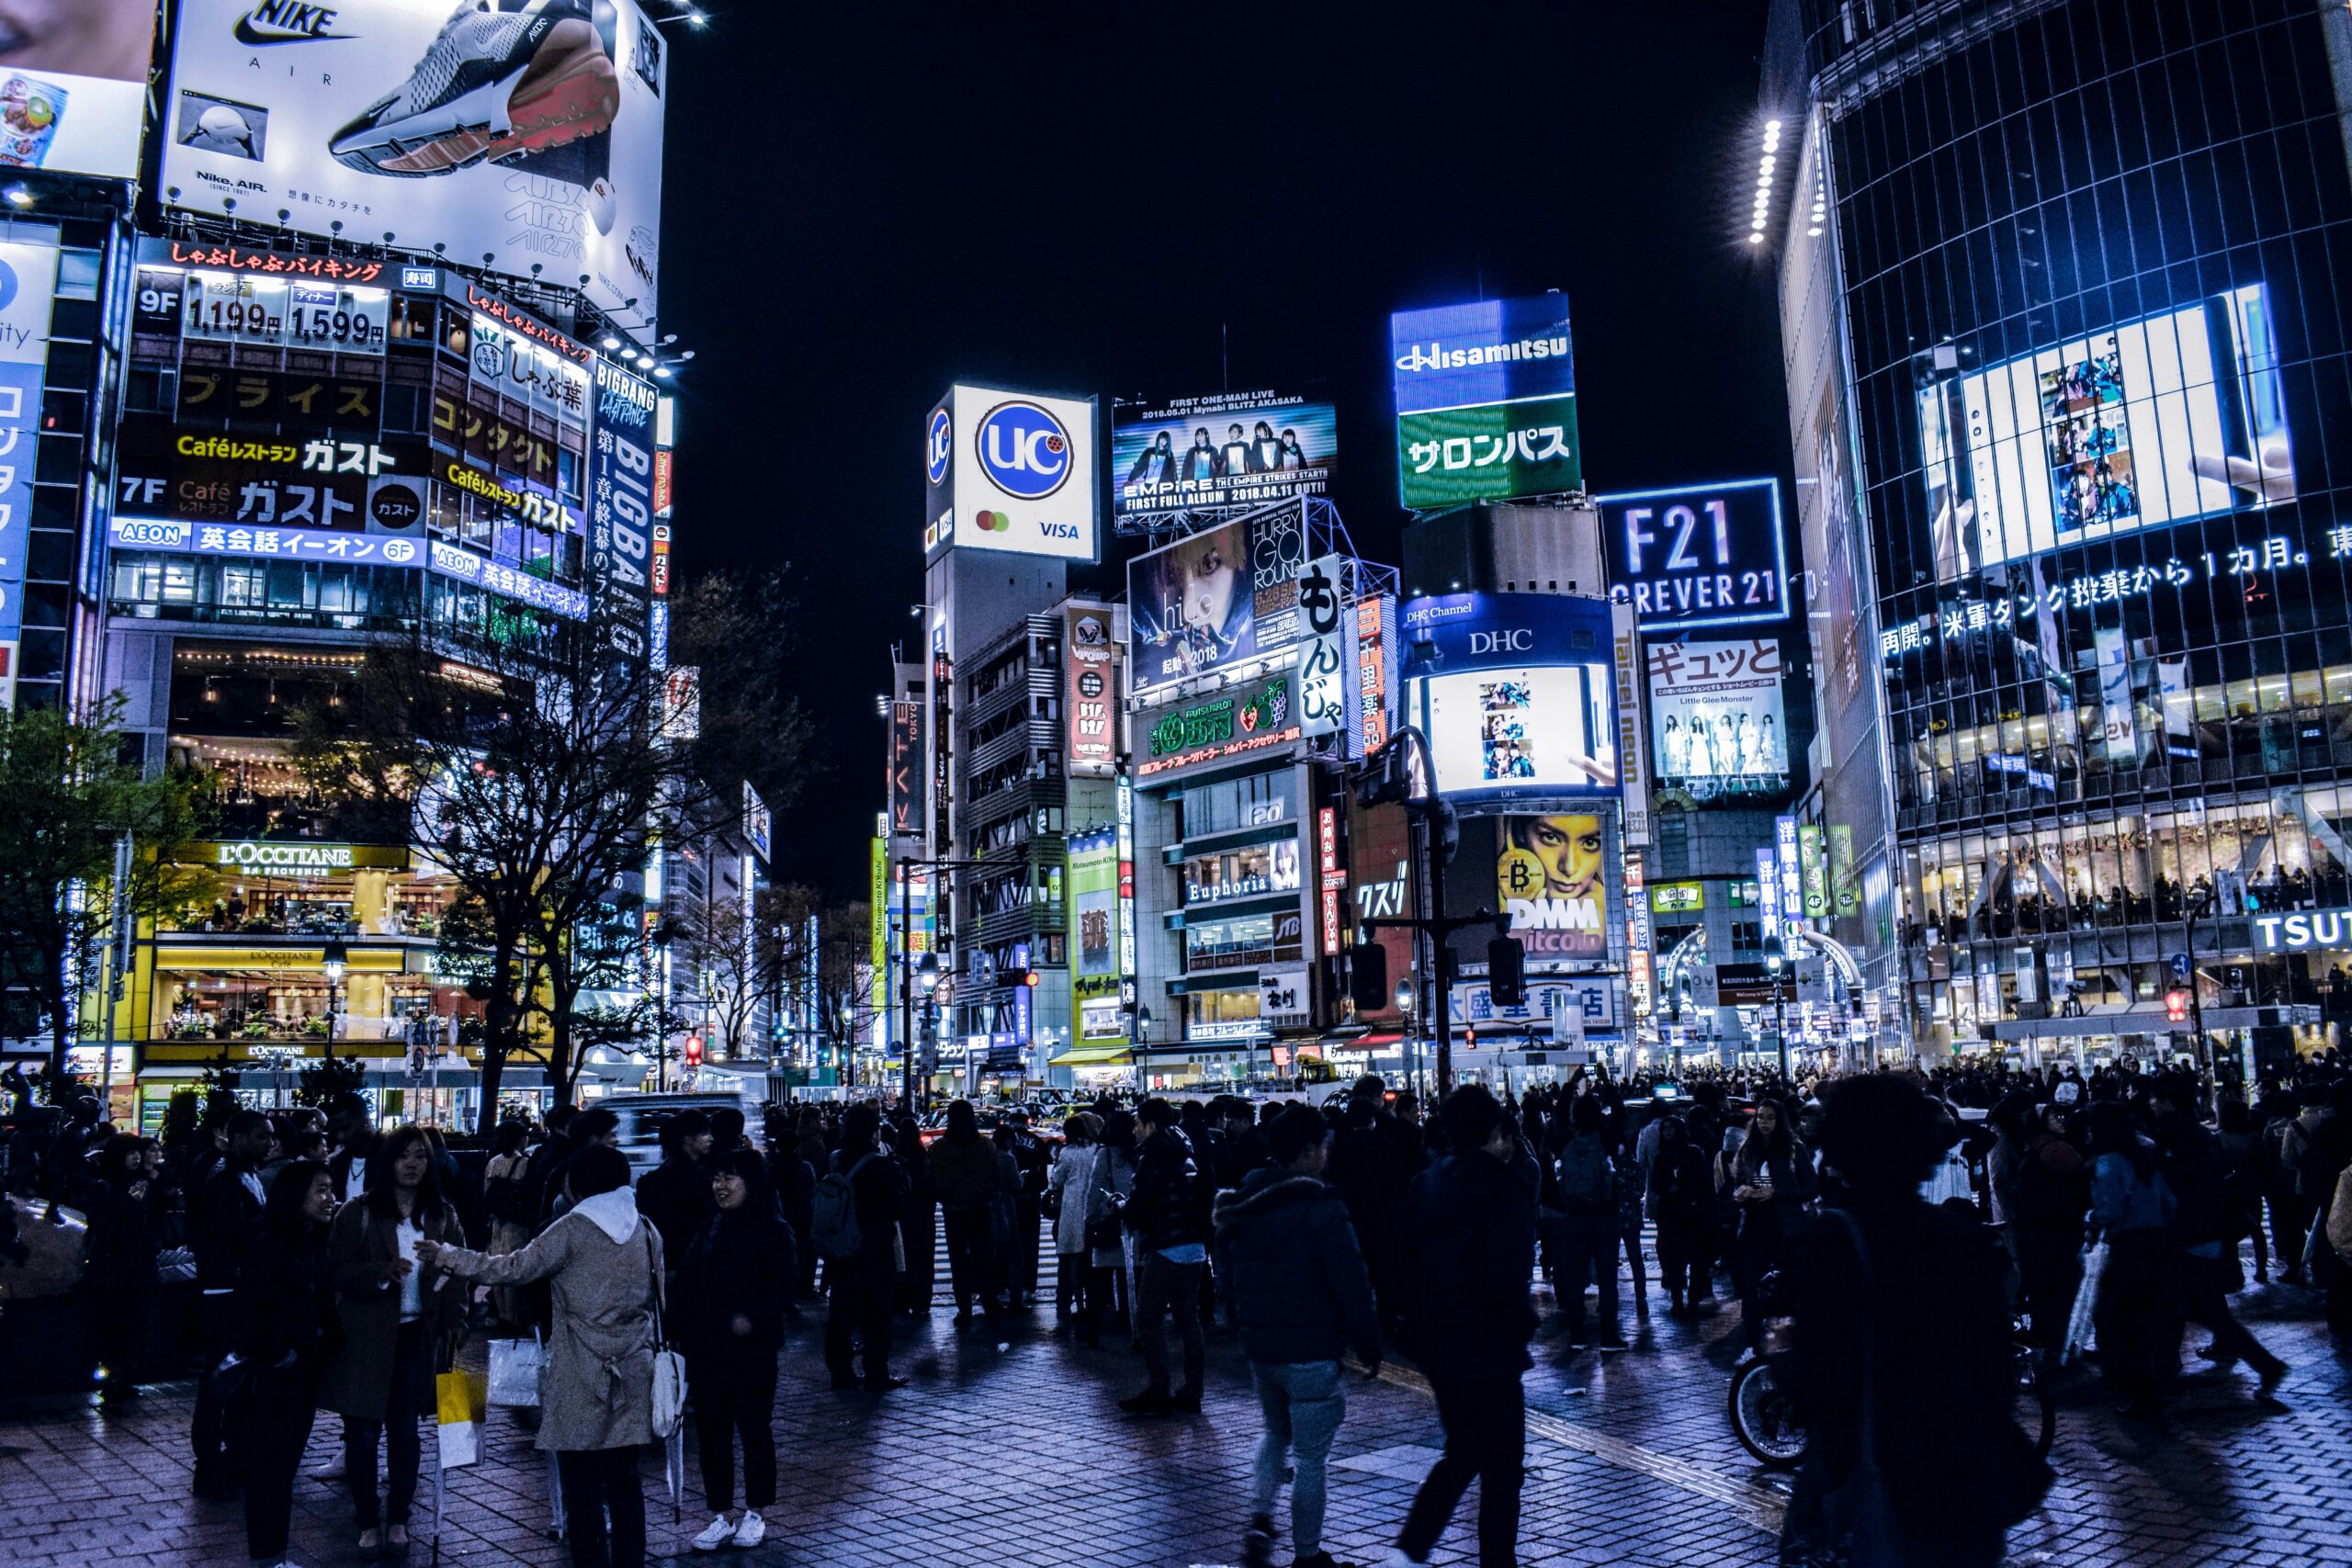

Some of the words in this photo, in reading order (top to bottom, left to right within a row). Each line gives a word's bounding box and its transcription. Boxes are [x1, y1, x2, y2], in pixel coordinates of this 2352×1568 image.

[254, 0, 338, 37] NIKE
[288, 188, 372, 216] 想像にカタチを
[171, 243, 383, 283] しゃぶしゃぶバイキング
[213, 281, 246, 295] ランチ
[405, 270, 433, 286] 寿司
[141, 289, 178, 313] 9F
[296, 290, 334, 304] ディナー
[467, 285, 593, 364] しゃぶしゃぶバイキング
[1396, 337, 1568, 372] Hisamitsu
[184, 373, 371, 417] プライス
[512, 350, 582, 412] しゃぶ葉
[596, 363, 655, 412] BIGBANG
[1142, 408, 1191, 420] 2018.05.01
[1227, 400, 1256, 411] BLITZ
[1258, 396, 1304, 407] AKASAKA
[433, 396, 552, 472] コンタクト
[302, 439, 395, 476] ガスト
[1408, 425, 1569, 474] サロンパス
[120, 476, 167, 503] 7F
[1159, 493, 1184, 507] FULL
[1187, 491, 1225, 505] ALBUM
[1231, 486, 1293, 502] 2018.04.11
[1295, 480, 1327, 493] OUT!!
[1216, 478, 1231, 488] THE
[236, 479, 355, 526] ガスト
[378, 502, 415, 517] ガスト
[521, 491, 576, 534] ガスト
[119, 525, 183, 544] AEON
[199, 526, 376, 558] 英会話イーオン
[1039, 521, 1080, 540] VISA
[1252, 510, 1301, 546] HURRY
[1624, 499, 1730, 574] F21
[387, 542, 411, 558] 6F
[435, 548, 476, 578] AEON
[1253, 529, 1302, 572] GO
[1610, 573, 1736, 615] OREVER
[1744, 569, 1775, 605] 21
[1163, 582, 1215, 632] hide
[1407, 608, 1429, 623] DHC
[1430, 603, 1473, 618] Channel
[1298, 563, 1343, 728] もんじゃ
[1470, 628, 1533, 655] DHC
[1881, 622, 1931, 658] 再開。
[1190, 647, 1218, 668] 2018
[1358, 607, 1381, 747] 三千里薬品
[1080, 702, 1104, 718] B1F
[1680, 696, 1701, 705] Little
[1702, 696, 1720, 705] Glee
[1721, 695, 1754, 704] Monster
[1080, 719, 1105, 735] B2F
[1621, 716, 1639, 785] neon
[897, 703, 909, 829] KATE
[910, 704, 918, 742] TOKYO
[1500, 789, 1521, 798] DHC
[219, 842, 353, 866] L'OCCITANE
[1072, 858, 1102, 870] Matsumoto
[1780, 821, 1802, 913] 洋服の青山
[264, 866, 328, 876] PROVENCE
[1190, 876, 1268, 902] Euphoria
[1357, 860, 1408, 919] クスリ
[1759, 860, 1778, 937] 洋服の青
[1808, 897, 1822, 907] 4F
[1506, 897, 1601, 930] DMM
[1275, 916, 1301, 942] JTB
[1510, 928, 1601, 953] itcoin
[250, 950, 313, 961] L'OCCITANE
